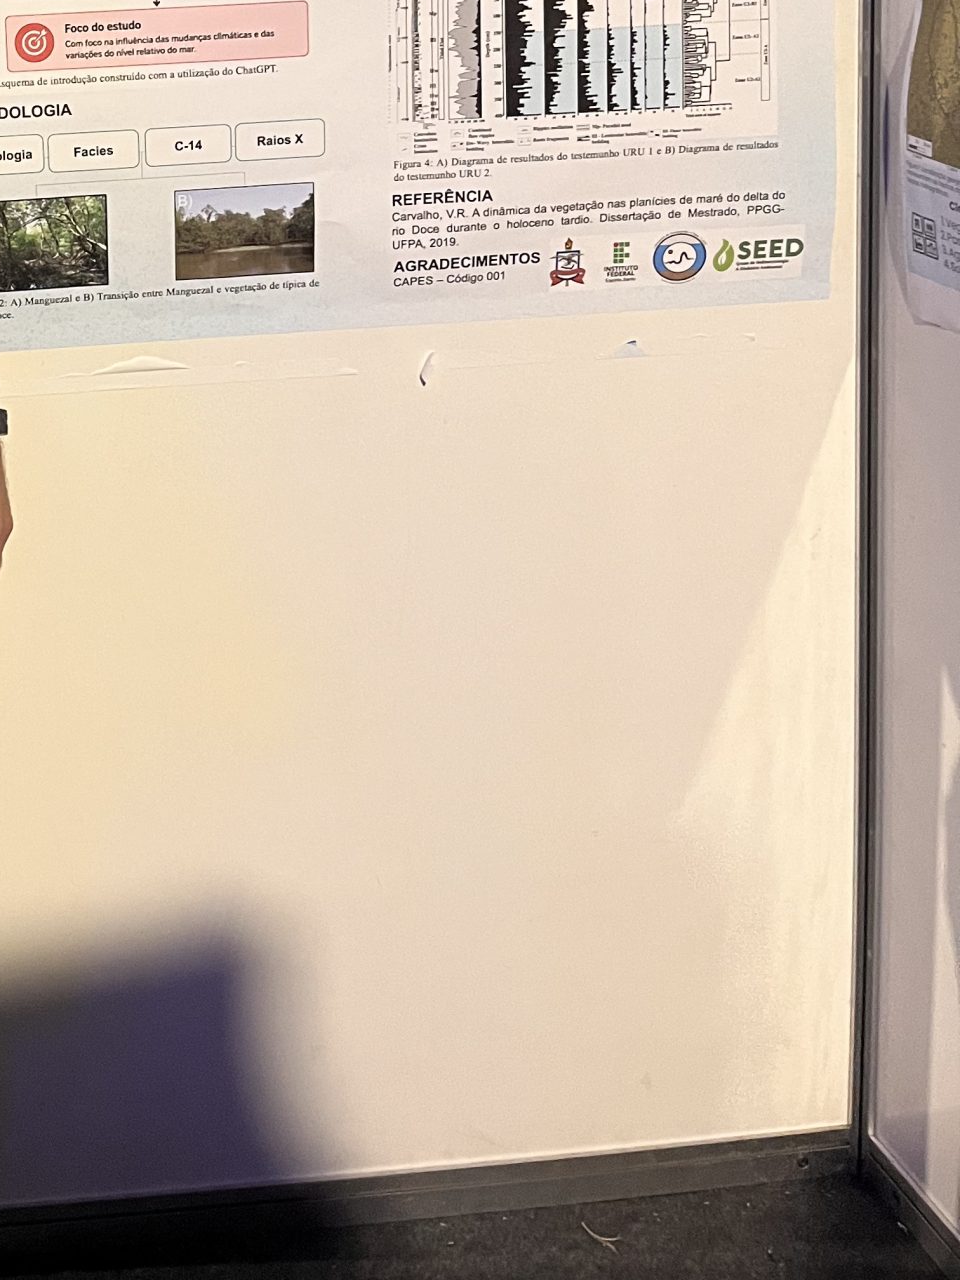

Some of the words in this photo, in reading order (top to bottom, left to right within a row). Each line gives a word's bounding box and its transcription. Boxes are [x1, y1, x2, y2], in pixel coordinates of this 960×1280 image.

[64, 23, 88, 33] Foco
[91, 22, 104, 31] do
[106, 20, 141, 31] estudo
[174, 139, 202, 151] C-14
[257, 135, 291, 146] Raios
[294, 133, 303, 143] X
[73, 145, 113, 157] Facies
[392, 188, 493, 206] REFERÊNCIA
[737, 238, 804, 260] SEED
[393, 251, 540, 272] AGRADECIMENTOS
[393, 275, 433, 287] CAPES
[446, 273, 483, 284] Código
[486, 270, 504, 280] 001
